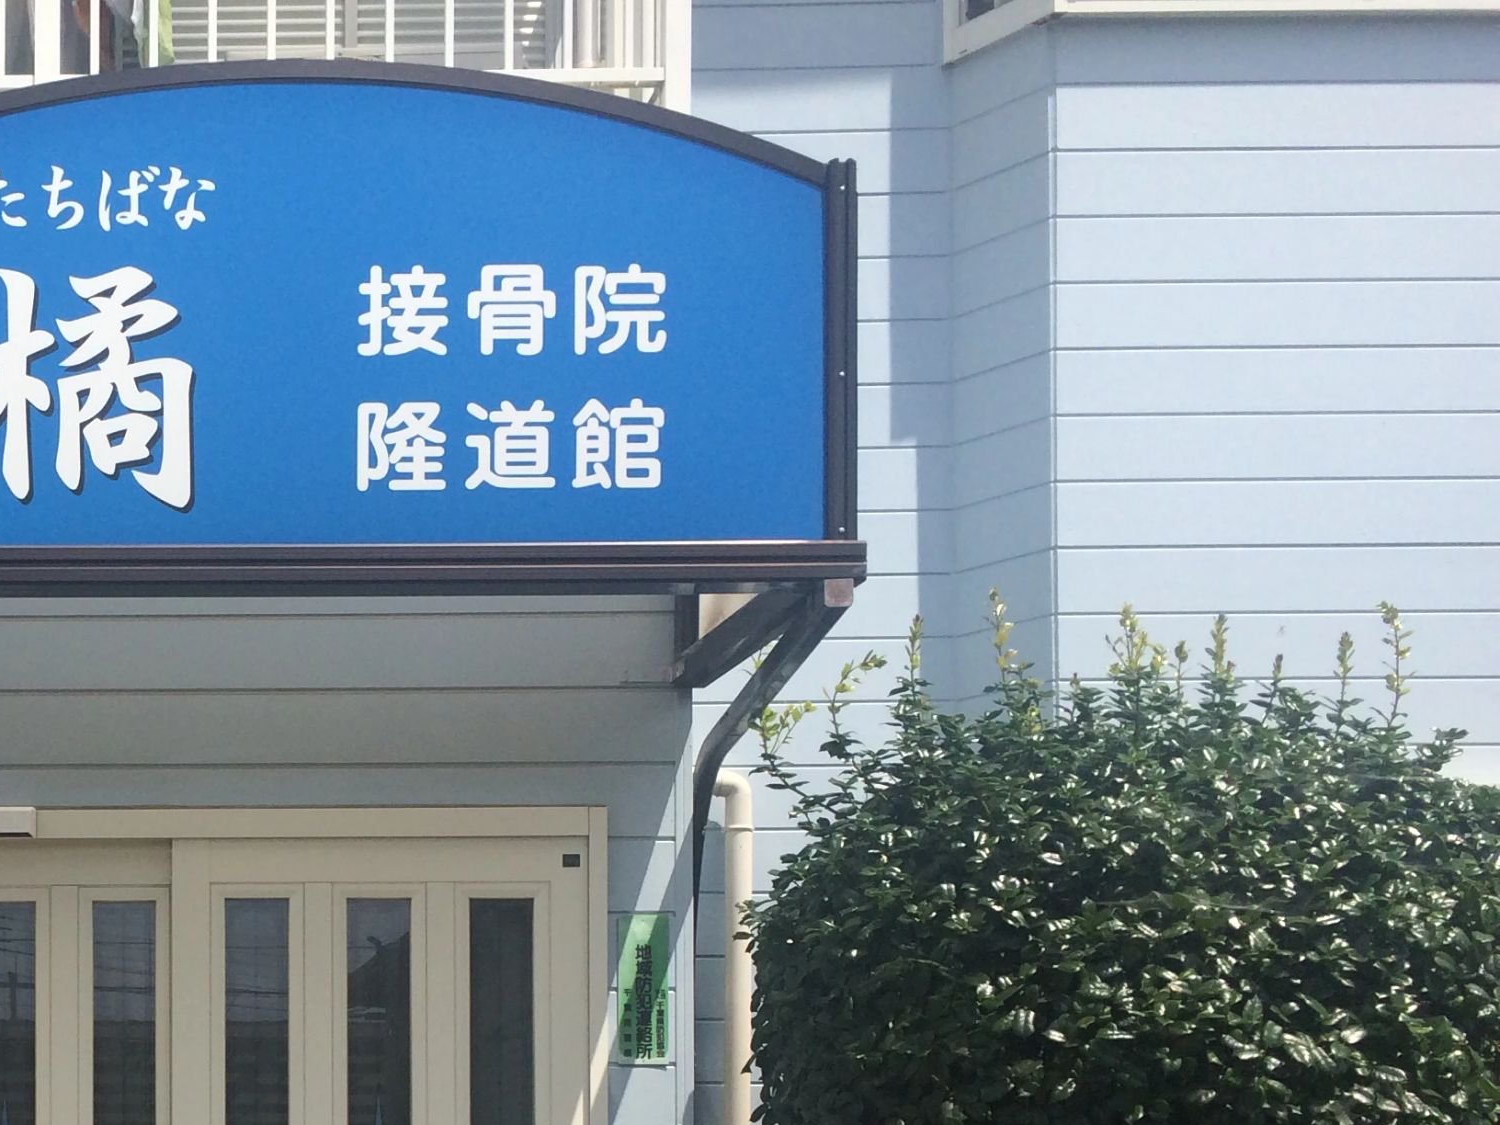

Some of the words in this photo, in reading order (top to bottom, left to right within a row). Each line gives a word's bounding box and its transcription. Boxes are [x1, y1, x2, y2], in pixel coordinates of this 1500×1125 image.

[357, 263, 668, 357] 接骨院
[356, 398, 666, 492] 隆道館
[635, 944, 653, 1060] 地域防犯連絡所
